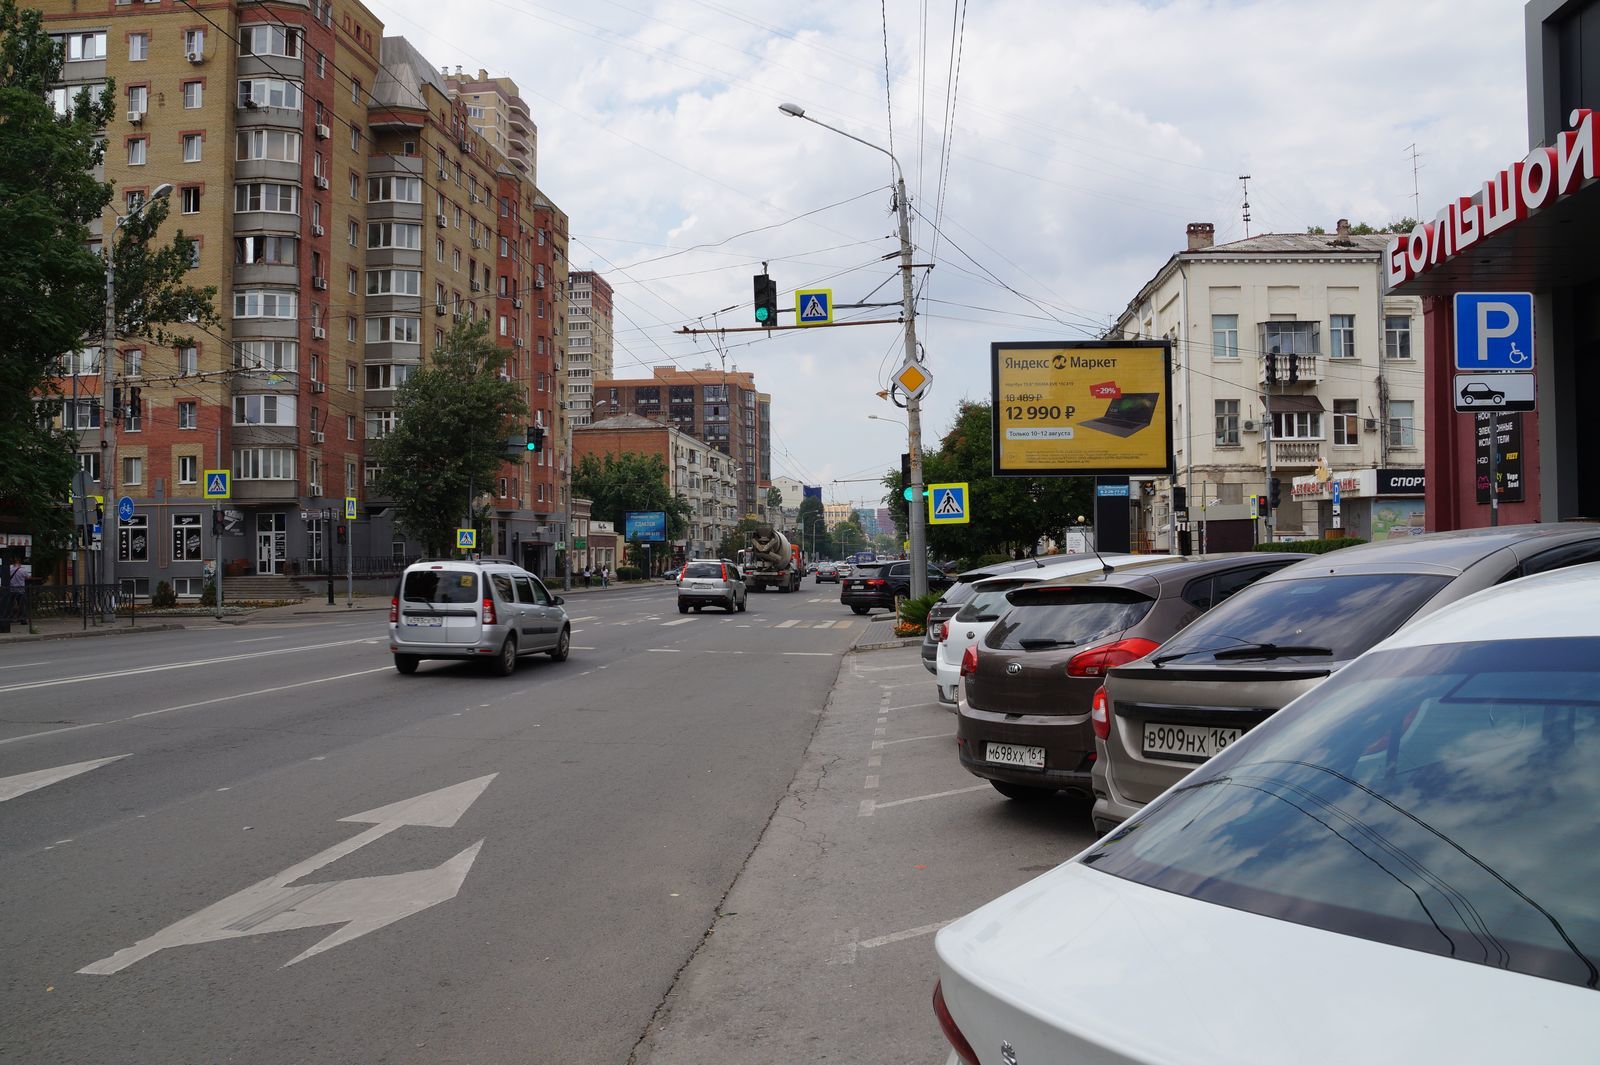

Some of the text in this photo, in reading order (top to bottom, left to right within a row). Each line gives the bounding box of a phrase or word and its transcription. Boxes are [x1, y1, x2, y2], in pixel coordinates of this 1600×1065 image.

[1387, 108, 1598, 288] БОЛЬШОЙ
[1477, 302, 1519, 360] P
[1005, 356, 1117, 371] Яндекс Маркет
[1017, 393, 1035, 402] 489
[1006, 406, 1076, 420] 12 990 ₽
[1325, 478, 1357, 492] ПИАНИЕ
[1148, 727, 1237, 753] В909НХ 161
[988, 746, 1041, 762] М698ХХ 161
